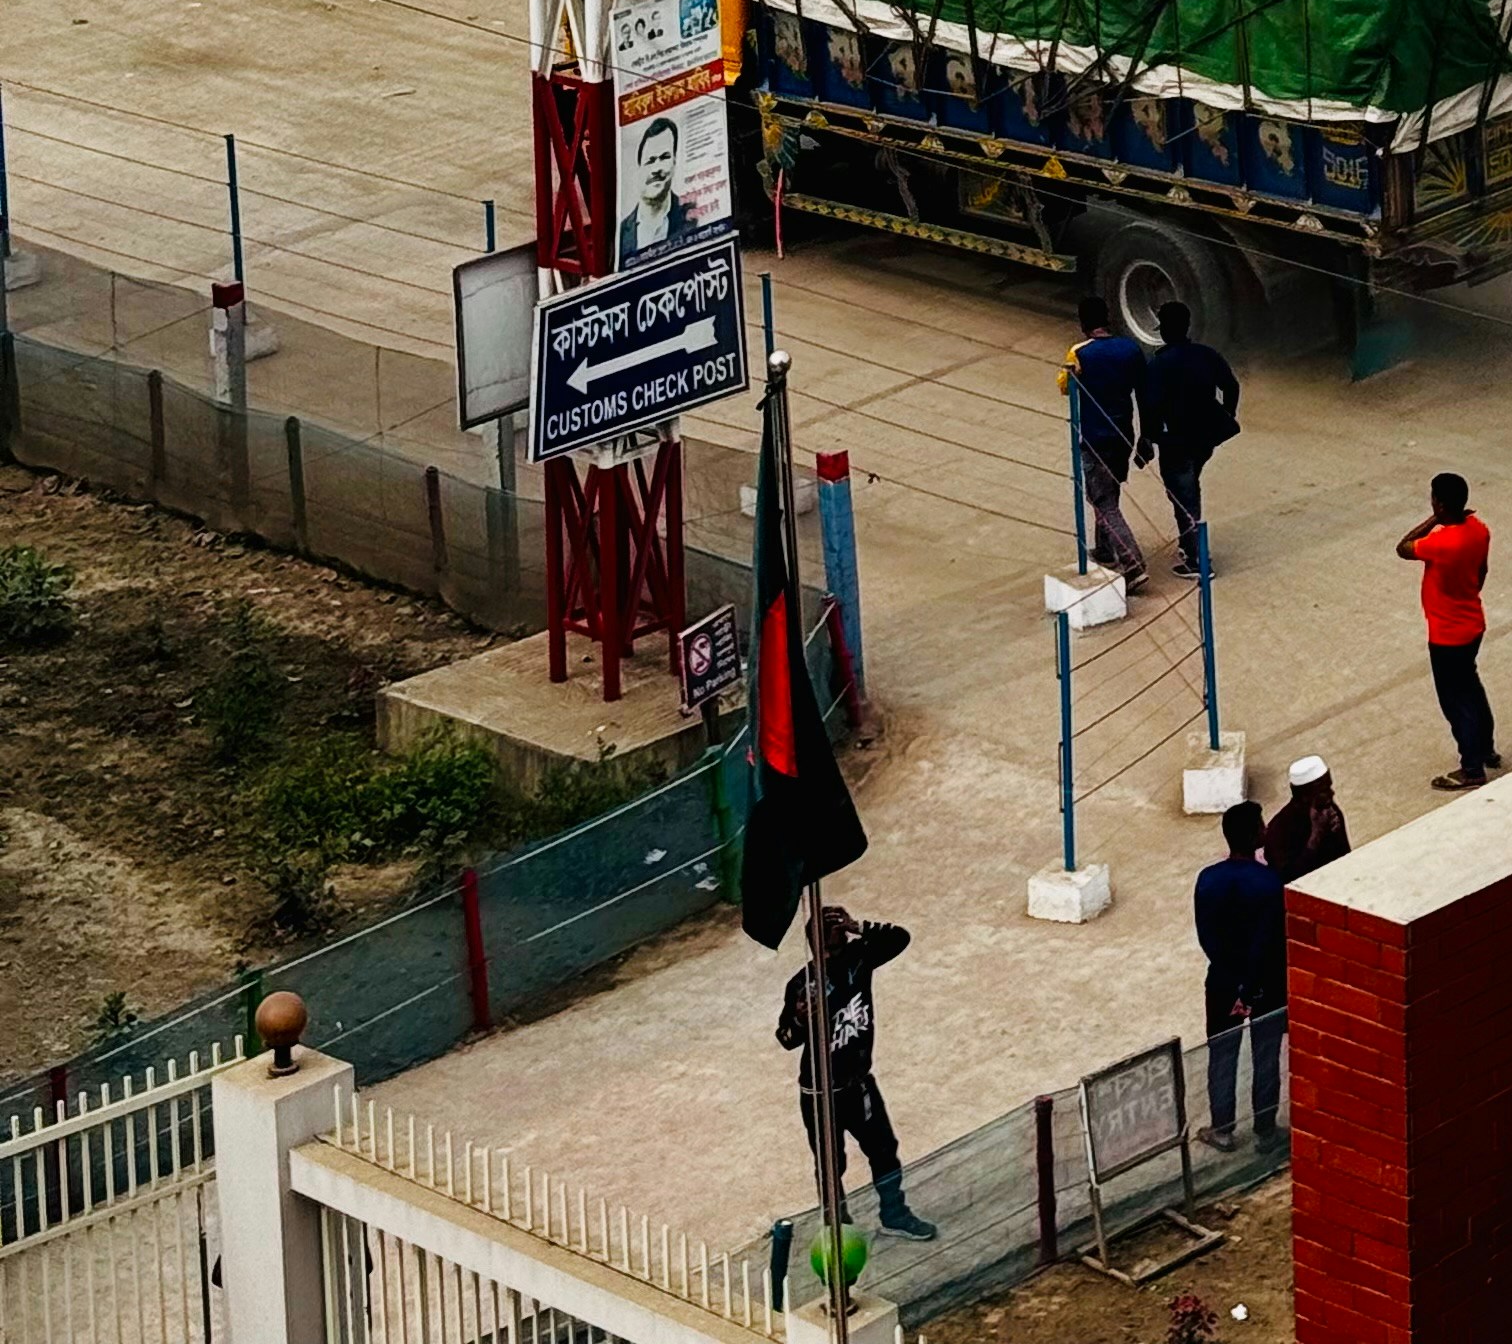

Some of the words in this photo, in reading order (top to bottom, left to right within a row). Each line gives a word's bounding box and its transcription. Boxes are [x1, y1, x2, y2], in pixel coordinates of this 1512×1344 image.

[551, 301, 631, 363] কাস্টমস
[635, 256, 731, 332] চেকপোস্ট
[546, 393, 629, 441] CUSTOMS
[631, 369, 689, 412] CHECK
[692, 351, 738, 387] POST
[692, 684, 706, 700] No
[705, 666, 737, 691] Parking
